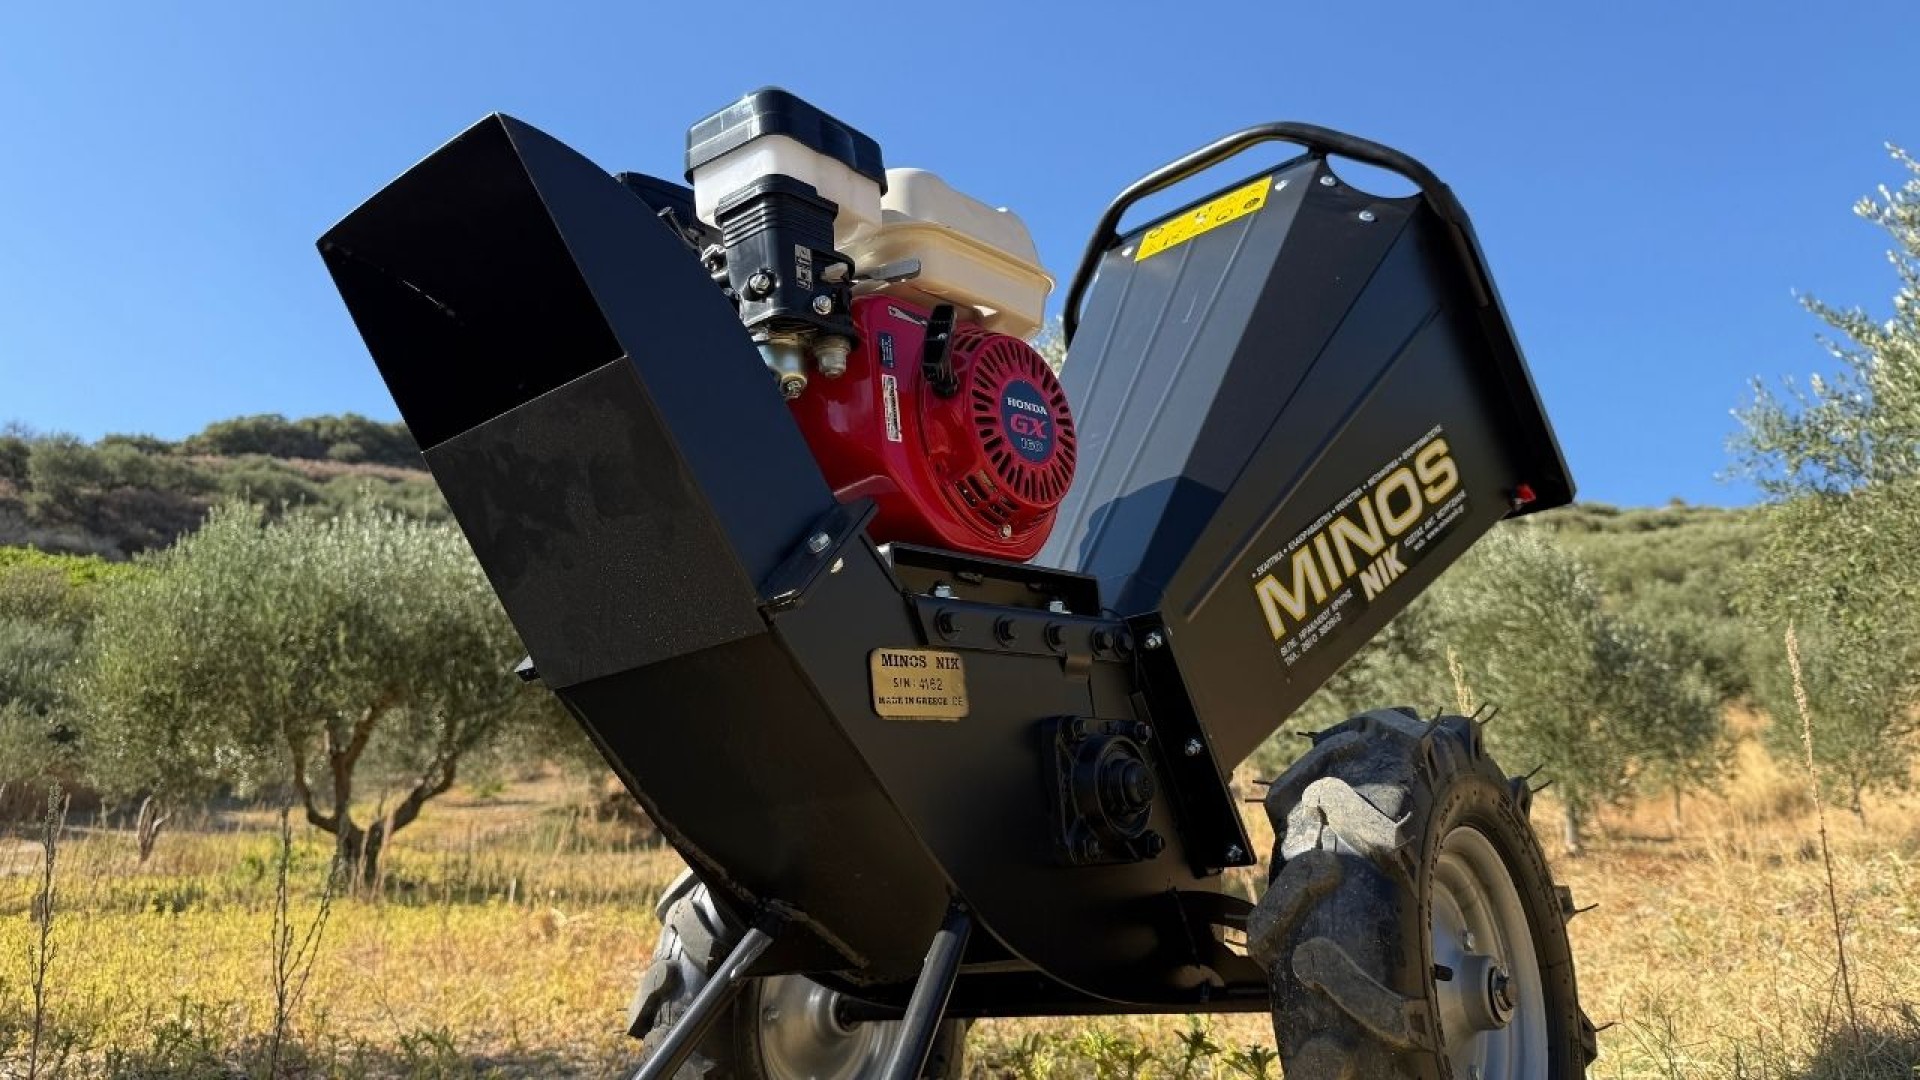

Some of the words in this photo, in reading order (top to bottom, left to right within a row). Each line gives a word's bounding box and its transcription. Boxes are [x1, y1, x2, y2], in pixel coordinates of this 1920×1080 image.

[1007, 396, 1048, 416] HONDA
[1010, 413, 1048, 439] GX
[1254, 437, 1459, 640] MINOS
[1358, 543, 1408, 602] NIK
[881, 653, 928, 668] MINOS
[935, 656, 960, 670] NIK
[878, 696, 904, 705] MADE
[905, 696, 914, 705] IN
[916, 697, 948, 706] GREECE
